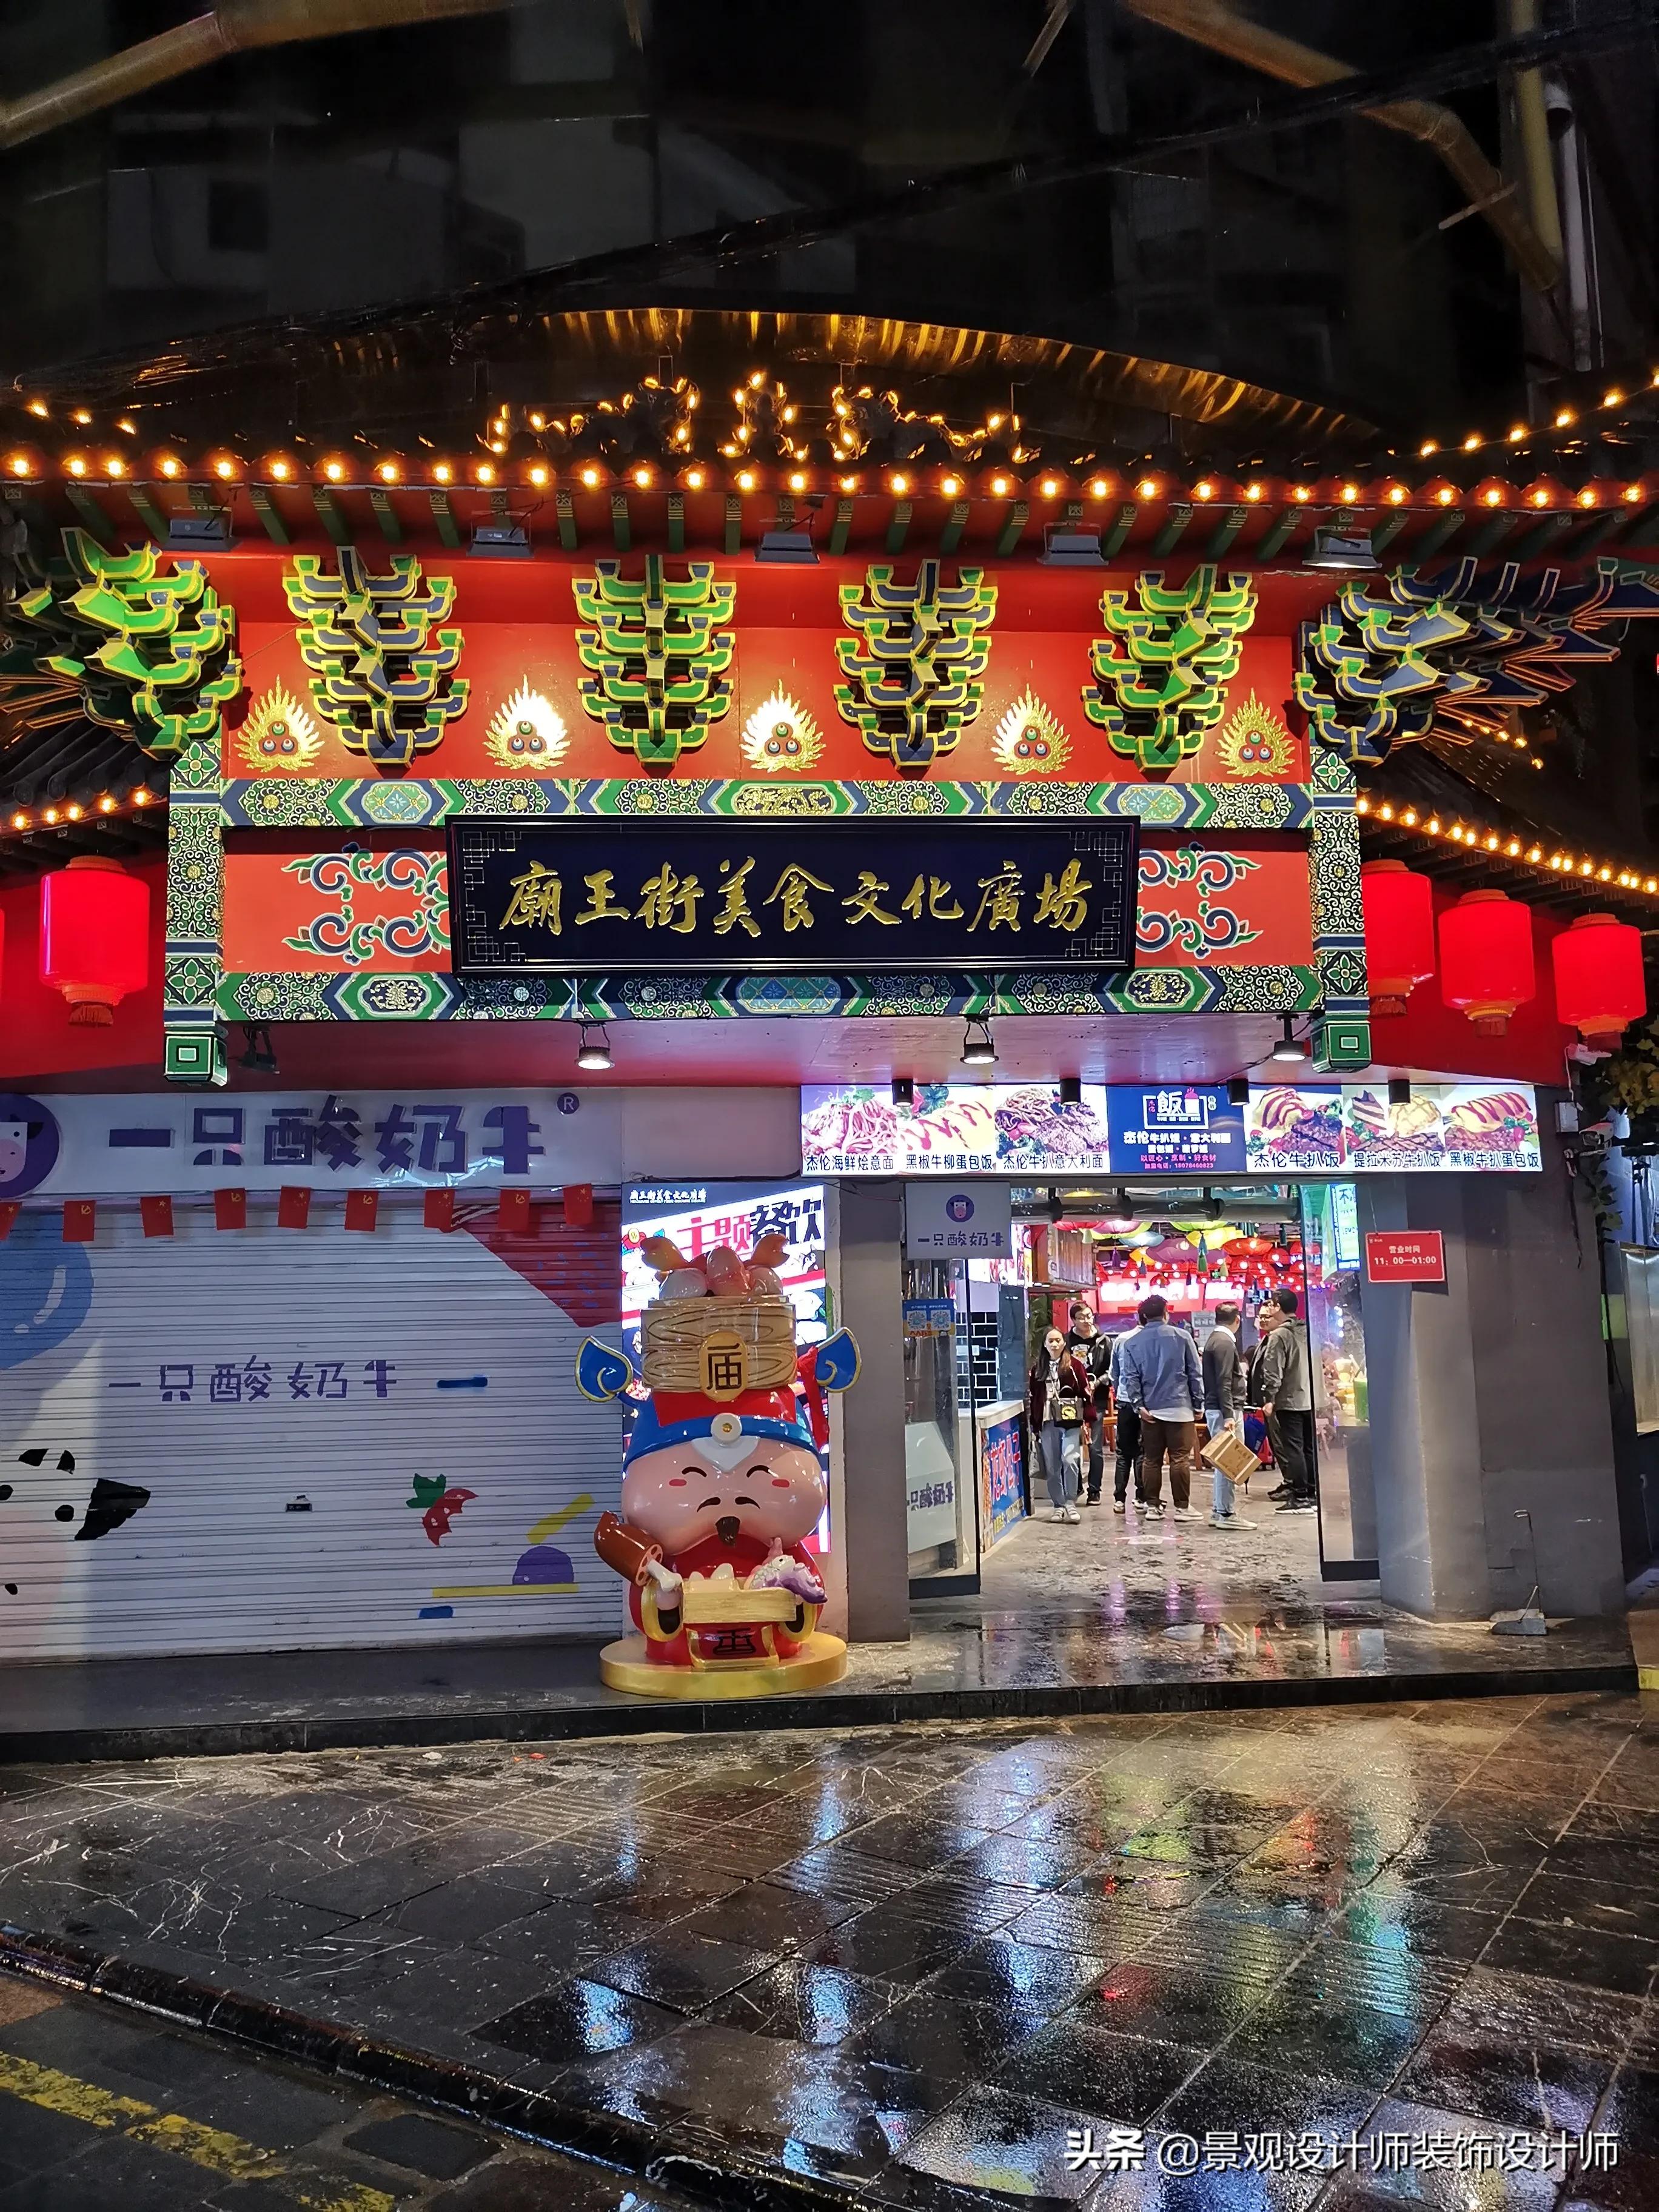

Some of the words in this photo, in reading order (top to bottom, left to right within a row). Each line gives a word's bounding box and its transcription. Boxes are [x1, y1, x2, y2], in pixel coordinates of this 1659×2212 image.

[498, 855, 1093, 939] 廟王街美食文化廣場
[109, 1094, 546, 1174] 一只酸奶牛
[806, 1154, 894, 1171] 杰伦海鲜烩意面
[906, 1154, 993, 1171] 黑椒牛柳蛋包饭
[1003, 1153, 1104, 1169] 杰伦牛扒意大利面
[1254, 1152, 1340, 1168] 杰伦牛扒饭
[1353, 1151, 1441, 1168] 提拉米苏牛扒饭
[1450, 1151, 1540, 1168] 黑椒牛扒蛋包饭
[917, 1230, 1005, 1248] 一只酸奶牛
[1389, 1245, 1421, 1254] 营业时间
[109, 1355, 398, 1404] 一只酸奶牛
